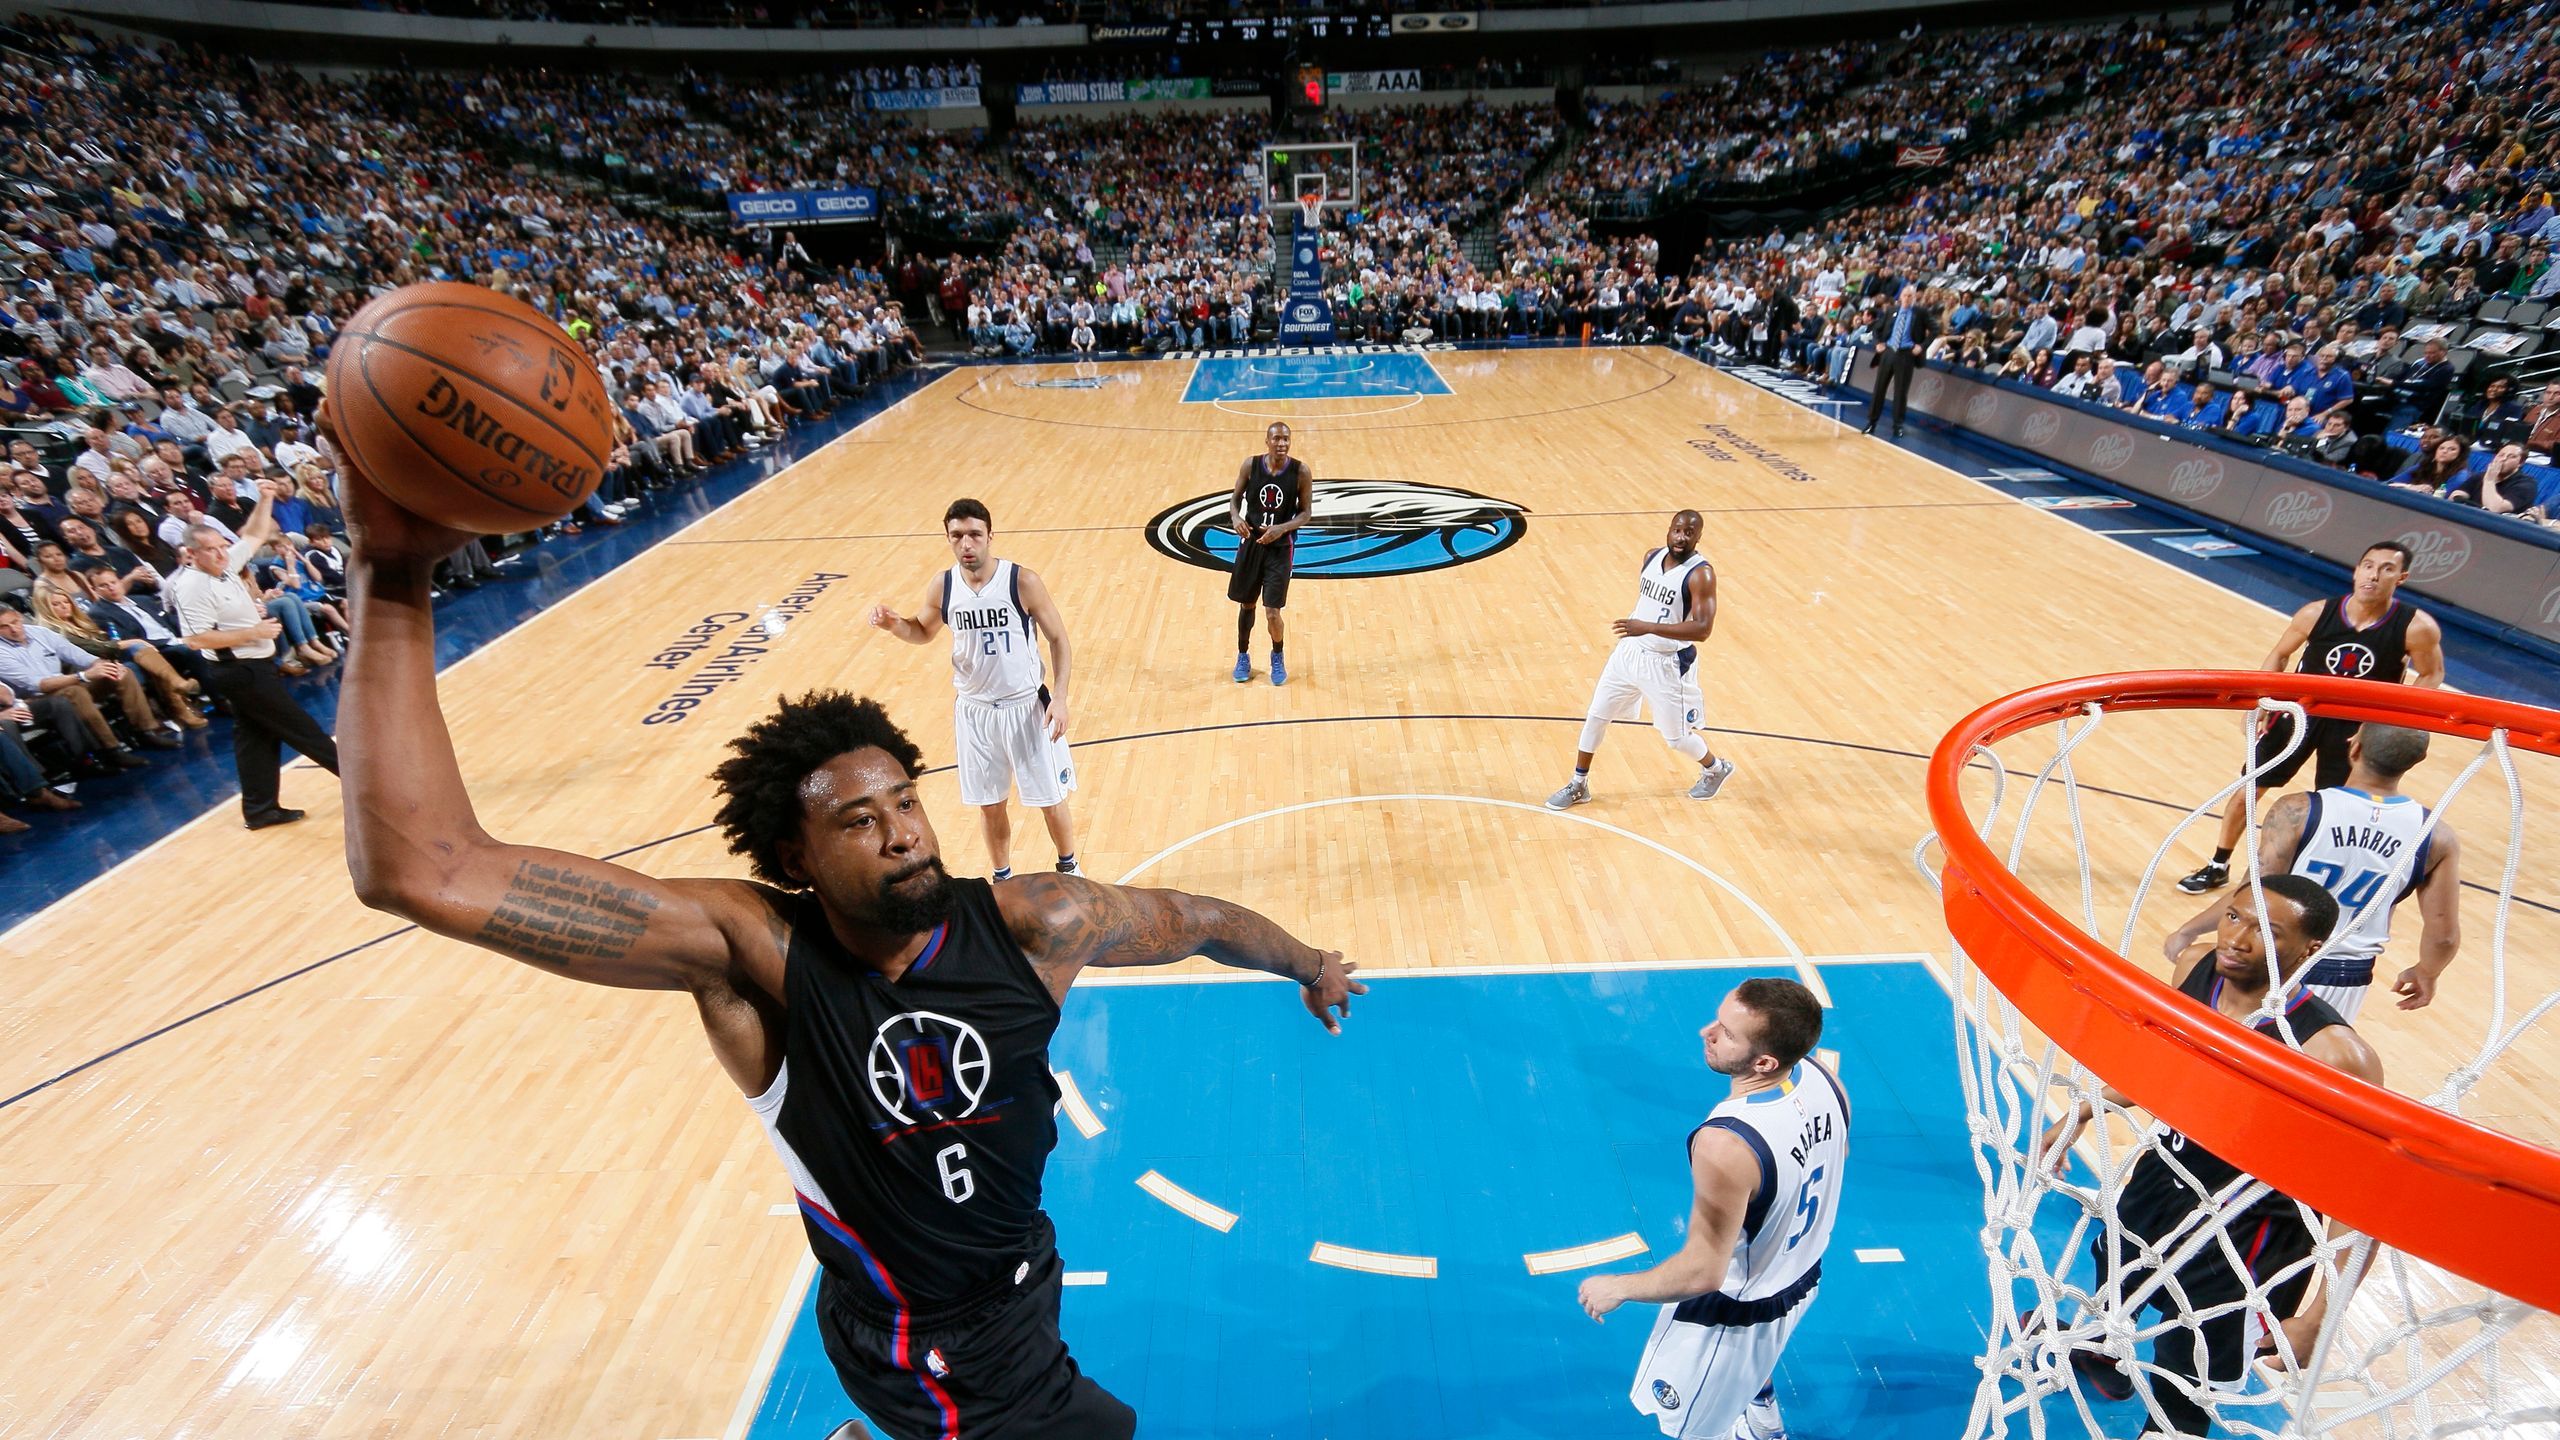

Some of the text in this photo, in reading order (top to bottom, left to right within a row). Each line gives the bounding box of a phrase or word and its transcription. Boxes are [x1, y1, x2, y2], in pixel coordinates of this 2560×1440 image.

[1099, 27, 1129, 38] BUD
[1129, 26, 1169, 37] LIGHT
[1232, 18, 1265, 27] MAVERICKS
[1313, 25, 1326, 37] 18
[1213, 30, 1219, 40] 0
[1242, 27, 1257, 40] 20
[1377, 71, 1419, 90] AAA
[1049, 83, 1087, 102] SOUND
[1089, 82, 1125, 101] STAGE
[1305, 81, 1320, 106] 9
[740, 199, 796, 215] GEICO
[816, 196, 870, 211] GEICO
[1293, 279, 1320, 287] Compass
[1299, 308, 1314, 316] FOX
[1284, 322, 1331, 333] SOUTHWEST
[417, 376, 593, 500] SPALDING
[1686, 439, 1739, 463] Center
[1261, 511, 1276, 528] 11
[1640, 576, 1676, 606] DALLAS
[955, 607, 1009, 631] DALLAS
[1657, 607, 1671, 624] 2
[641, 572, 849, 725] AmerianAirlines
[644, 612, 750, 670] Center
[982, 630, 1012, 656] 27
[2331, 825, 2402, 859] HARRIS
[1790, 1112, 1832, 1168] BAREA
[936, 1143, 975, 1204] 6
[1784, 1162, 1825, 1255] 5
